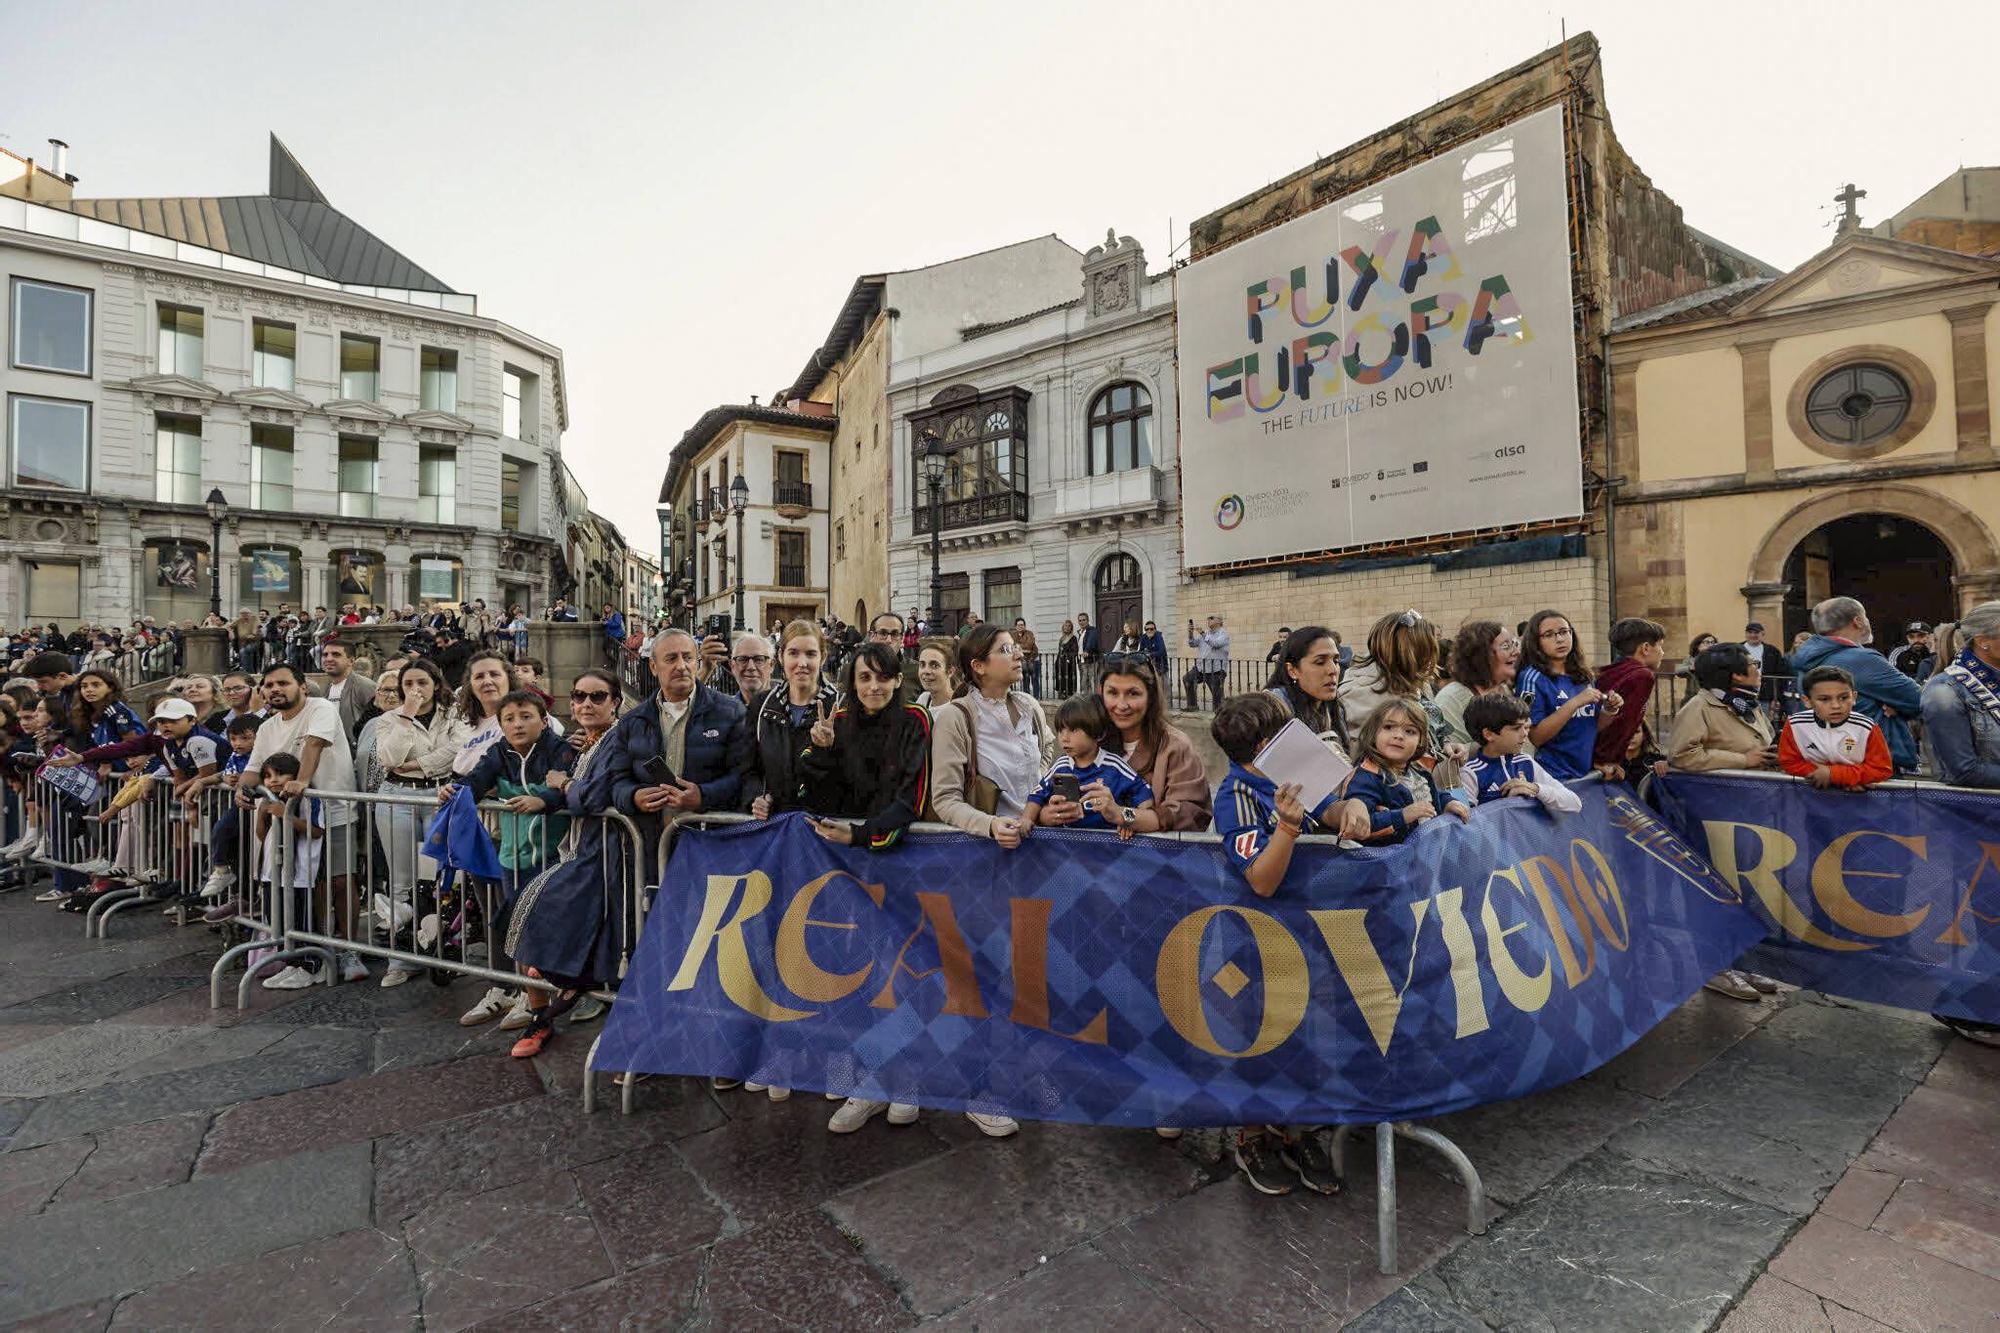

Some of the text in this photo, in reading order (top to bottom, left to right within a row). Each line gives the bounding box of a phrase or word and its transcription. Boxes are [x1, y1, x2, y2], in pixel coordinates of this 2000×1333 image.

[1247, 215, 1464, 344] PUXA
[1206, 274, 1535, 424] EUROPA
[1261, 373, 1453, 435] THE FUTURE IS NOW!
[1494, 444, 1526, 458] alsa
[667, 838, 1629, 1059] REAL OVIEDO
